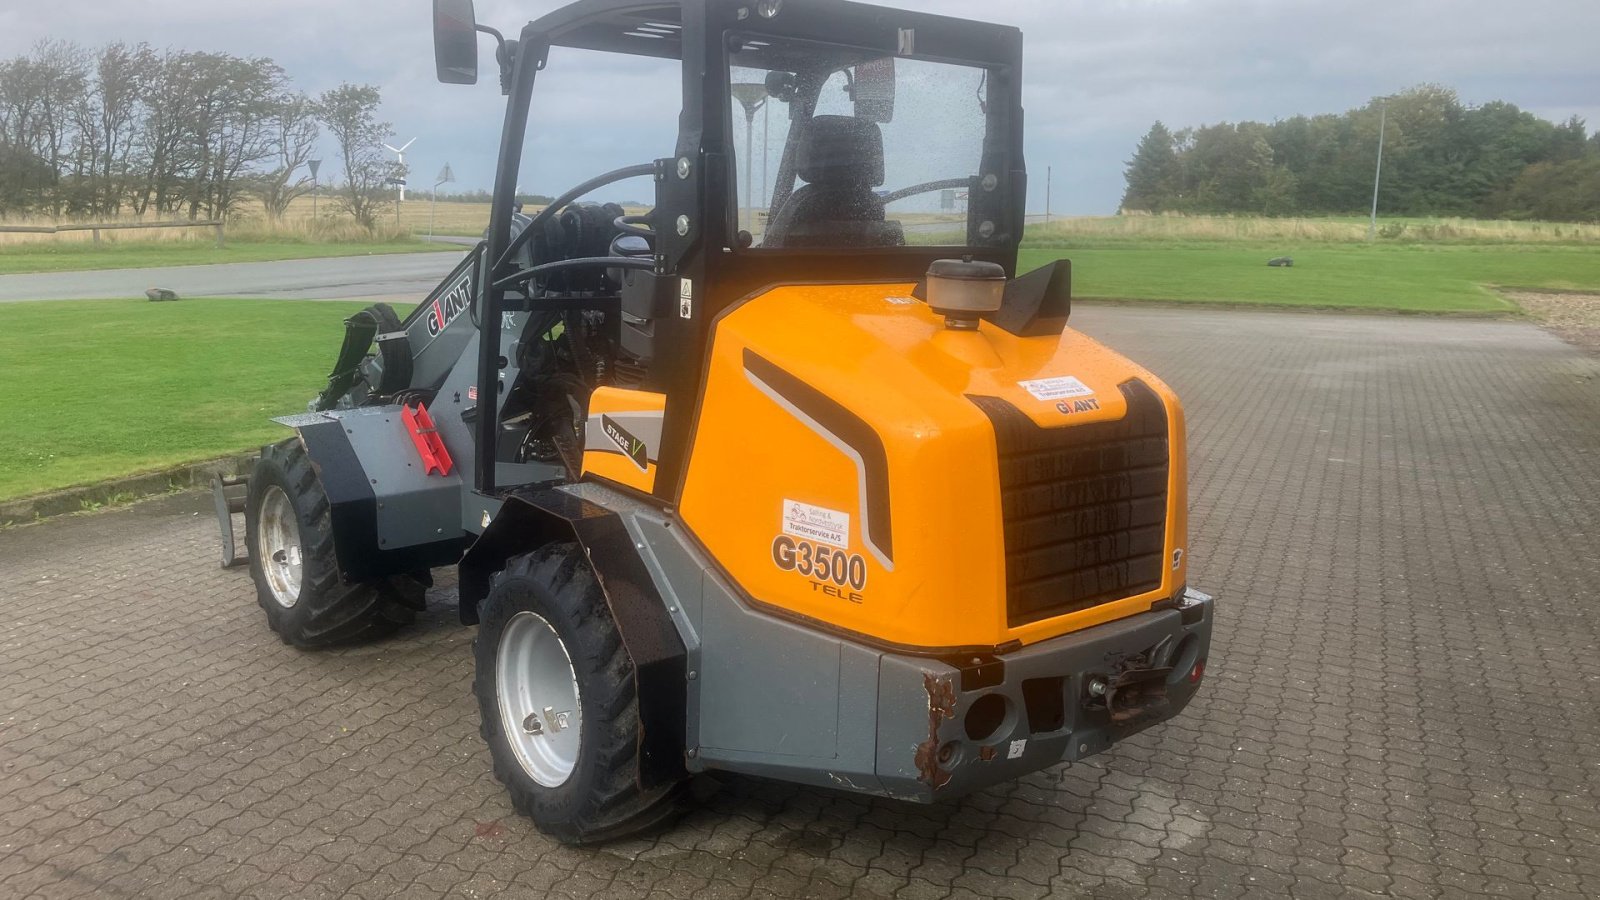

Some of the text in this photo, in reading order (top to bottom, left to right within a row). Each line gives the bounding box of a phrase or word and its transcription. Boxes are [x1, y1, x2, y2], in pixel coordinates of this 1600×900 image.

[427, 275, 471, 338] GIANT
[1056, 398, 1100, 415] GIANT
[606, 424, 645, 456] STAGE V
[789, 522, 830, 539] Traktorservice
[830, 532, 842, 542] A/S
[772, 534, 867, 592] G3500
[809, 580, 864, 605] TELE
